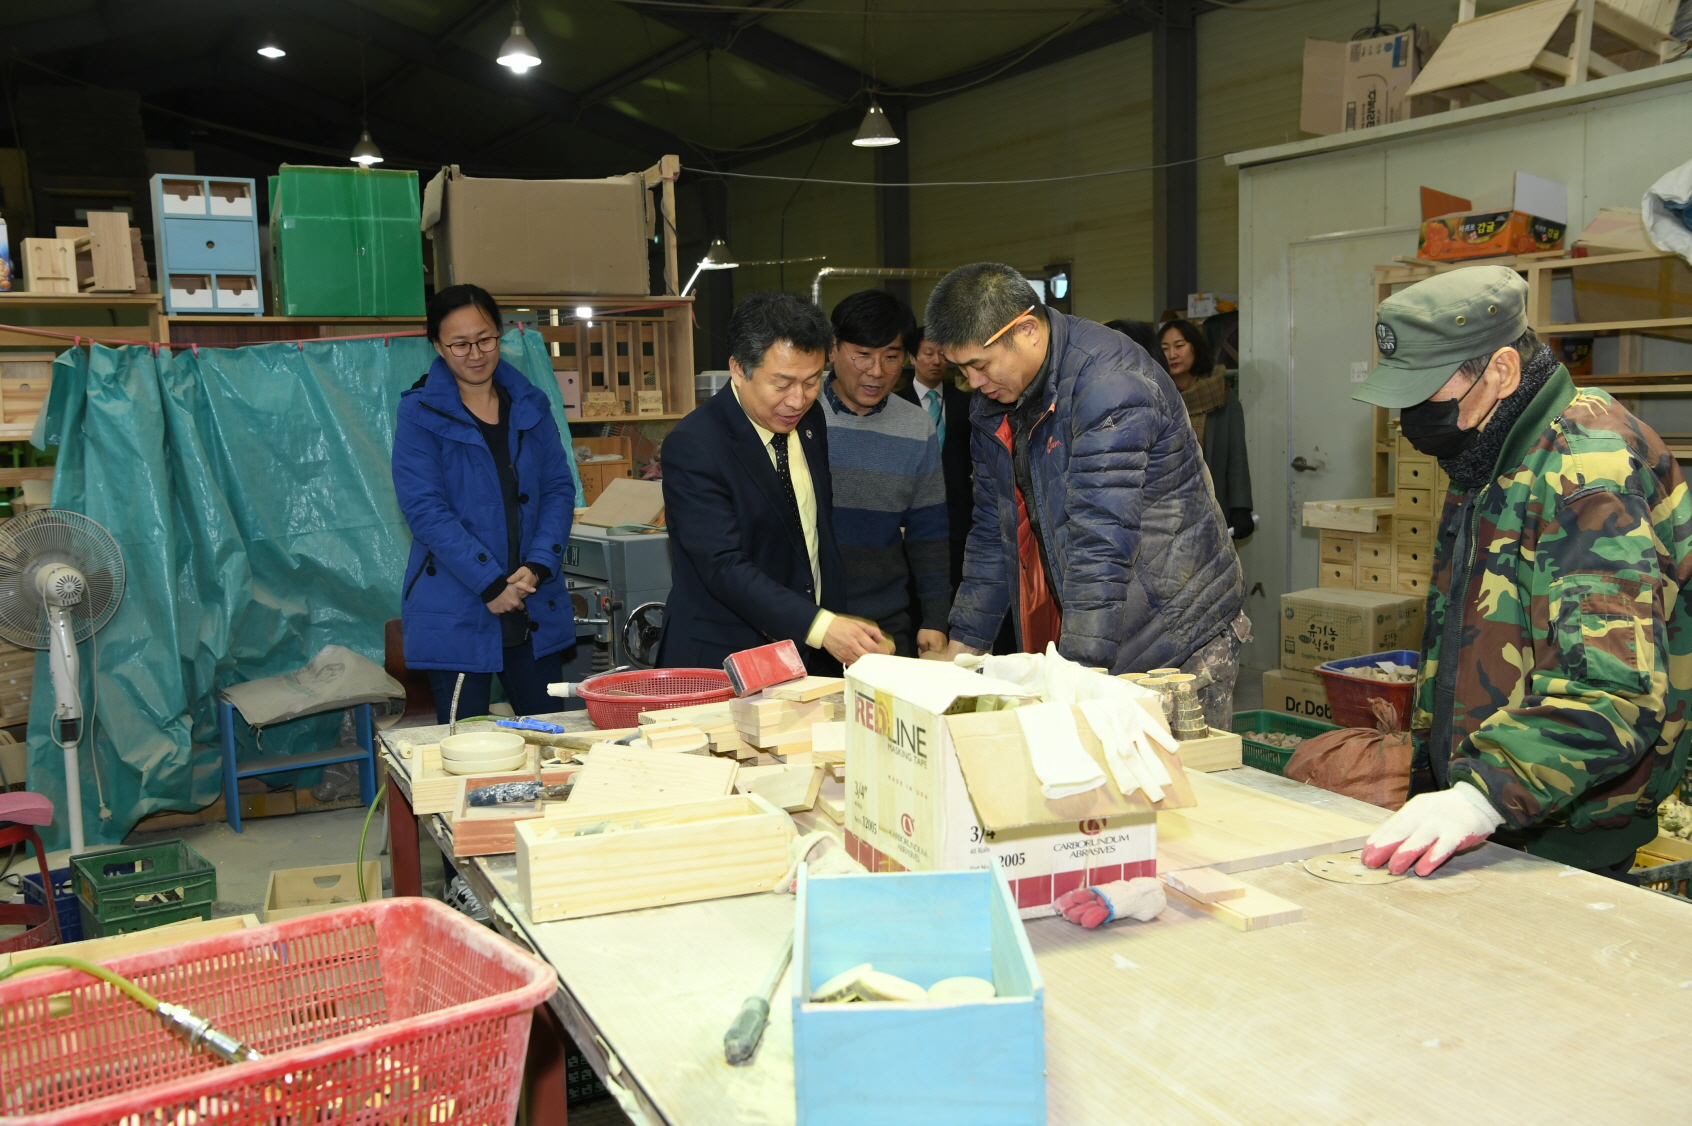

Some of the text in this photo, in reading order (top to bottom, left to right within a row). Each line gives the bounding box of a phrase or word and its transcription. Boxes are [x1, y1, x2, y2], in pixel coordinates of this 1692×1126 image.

[1476, 221, 1496, 234] 감귤
[1307, 623, 1339, 642] 유기농
[887, 742, 928, 770] MASKING TAPE
[888, 774, 903, 787] MADE
[916, 789, 928, 800] USA
[862, 815, 877, 835] 12005
[889, 828, 928, 858] CARBORUNDUM
[897, 843, 921, 863] ABRASIVES
[1053, 834, 1130, 853] CARBORUNDUM
[1069, 845, 1116, 859] ABRASIVES
